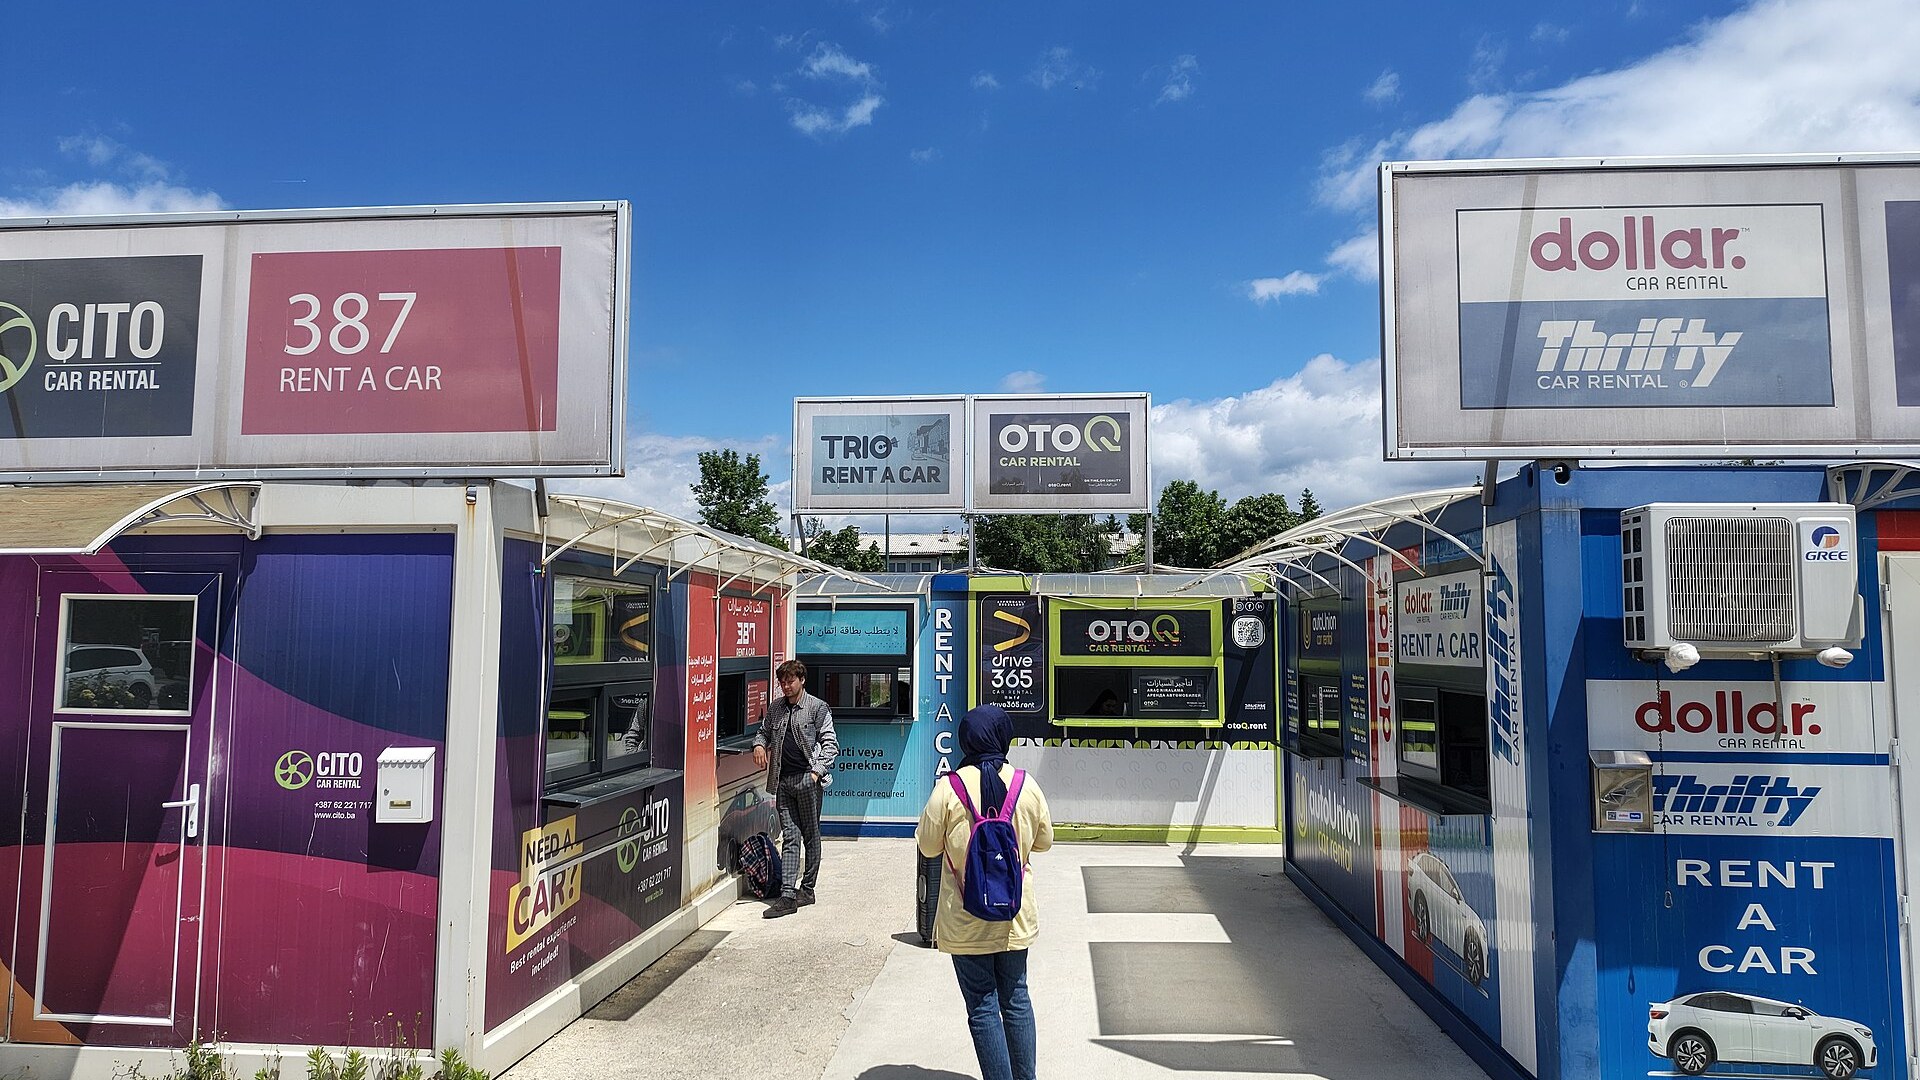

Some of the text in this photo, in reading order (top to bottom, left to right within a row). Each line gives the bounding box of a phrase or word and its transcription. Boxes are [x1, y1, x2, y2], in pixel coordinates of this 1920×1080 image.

[1626, 275, 1728, 291] CAR RENTAL
[285, 292, 418, 355] 387
[1536, 317, 1743, 388] Thrifty
[44, 370, 160, 391] CAR RENTAL
[280, 365, 442, 393] RENT A CAR
[1537, 374, 1668, 390] CAR RENTAL
[821, 435, 893, 459] TRIO
[1000, 456, 1081, 467] CAR RENTAL
[822, 465, 941, 483] RENT A CAR
[1805, 551, 1848, 561] GREE
[1440, 583, 1471, 619] Thrifty
[736, 622, 756, 644] 387
[839, 626, 862, 636] بطاقة
[1089, 644, 1150, 652] CAR RENTAL
[1401, 632, 1479, 659] RENT A CAR
[992, 653, 1033, 667] drive
[991, 669, 1033, 688] 365
[935, 608, 953, 784] RENT A CA
[1509, 628, 1520, 767] CAR RENTAL
[857, 749, 884, 759] veya
[1718, 738, 1806, 749] CAR RENTAL
[316, 752, 363, 776] CITO
[839, 760, 894, 772] gerekmez
[316, 779, 361, 789] CAR RENTAL
[823, 789, 905, 798] nd credit card required
[314, 801, 373, 809] +387 62 221 717
[1652, 775, 1822, 827] Thrifty
[314, 811, 356, 819] www.cito.ba
[1309, 784, 1361, 846] autoUnion
[1653, 815, 1758, 826] CAR RENTAL
[525, 828, 574, 868] NEED A
[642, 846, 652, 862] CAR
[1318, 831, 1353, 875] car rental
[1676, 859, 1835, 890] RENT
[513, 862, 578, 936] CAR?
[1736, 903, 1776, 932] A
[510, 916, 577, 974] Best rental experience
[531, 944, 559, 977] included!
[1697, 945, 1818, 976] CAR
